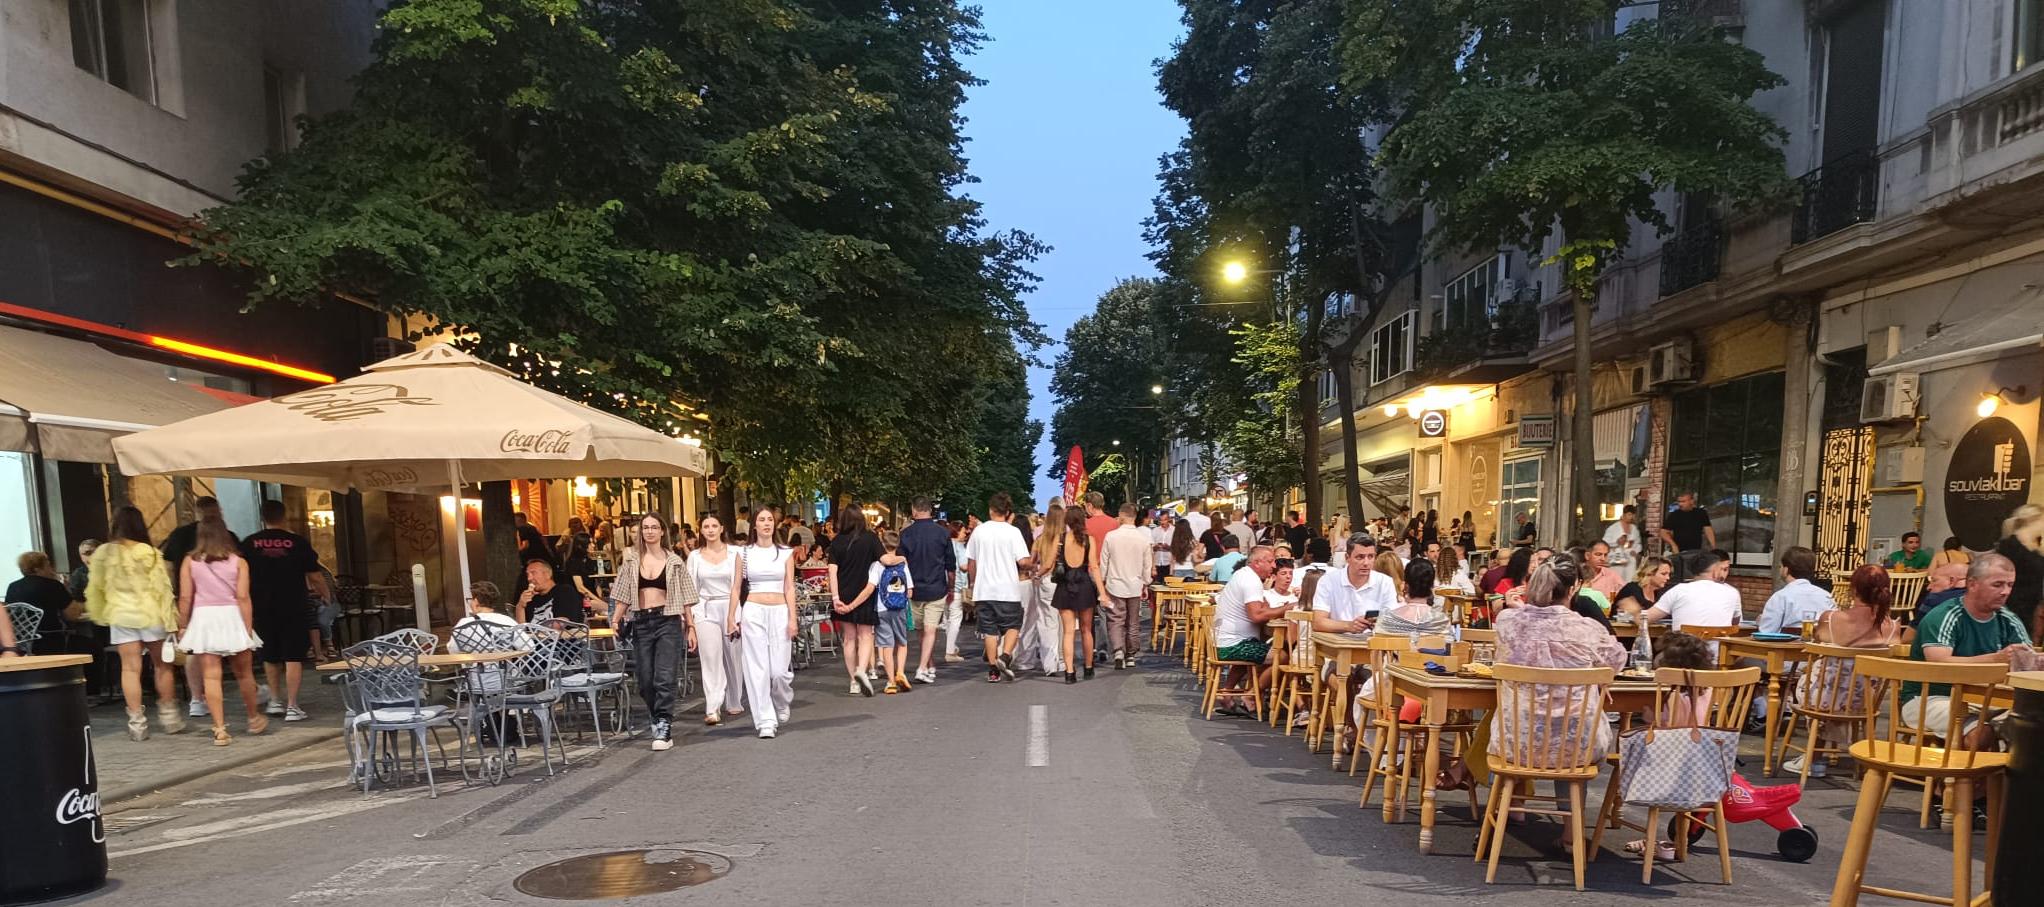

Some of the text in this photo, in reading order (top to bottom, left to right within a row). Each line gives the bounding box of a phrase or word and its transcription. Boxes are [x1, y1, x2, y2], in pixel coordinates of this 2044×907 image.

[1523, 423, 1552, 439] BIJUTERIE
[500, 429, 573, 454] Coca-Cola
[1949, 476, 2026, 492] souvlaki bar
[254, 539, 293, 549] HUGO
